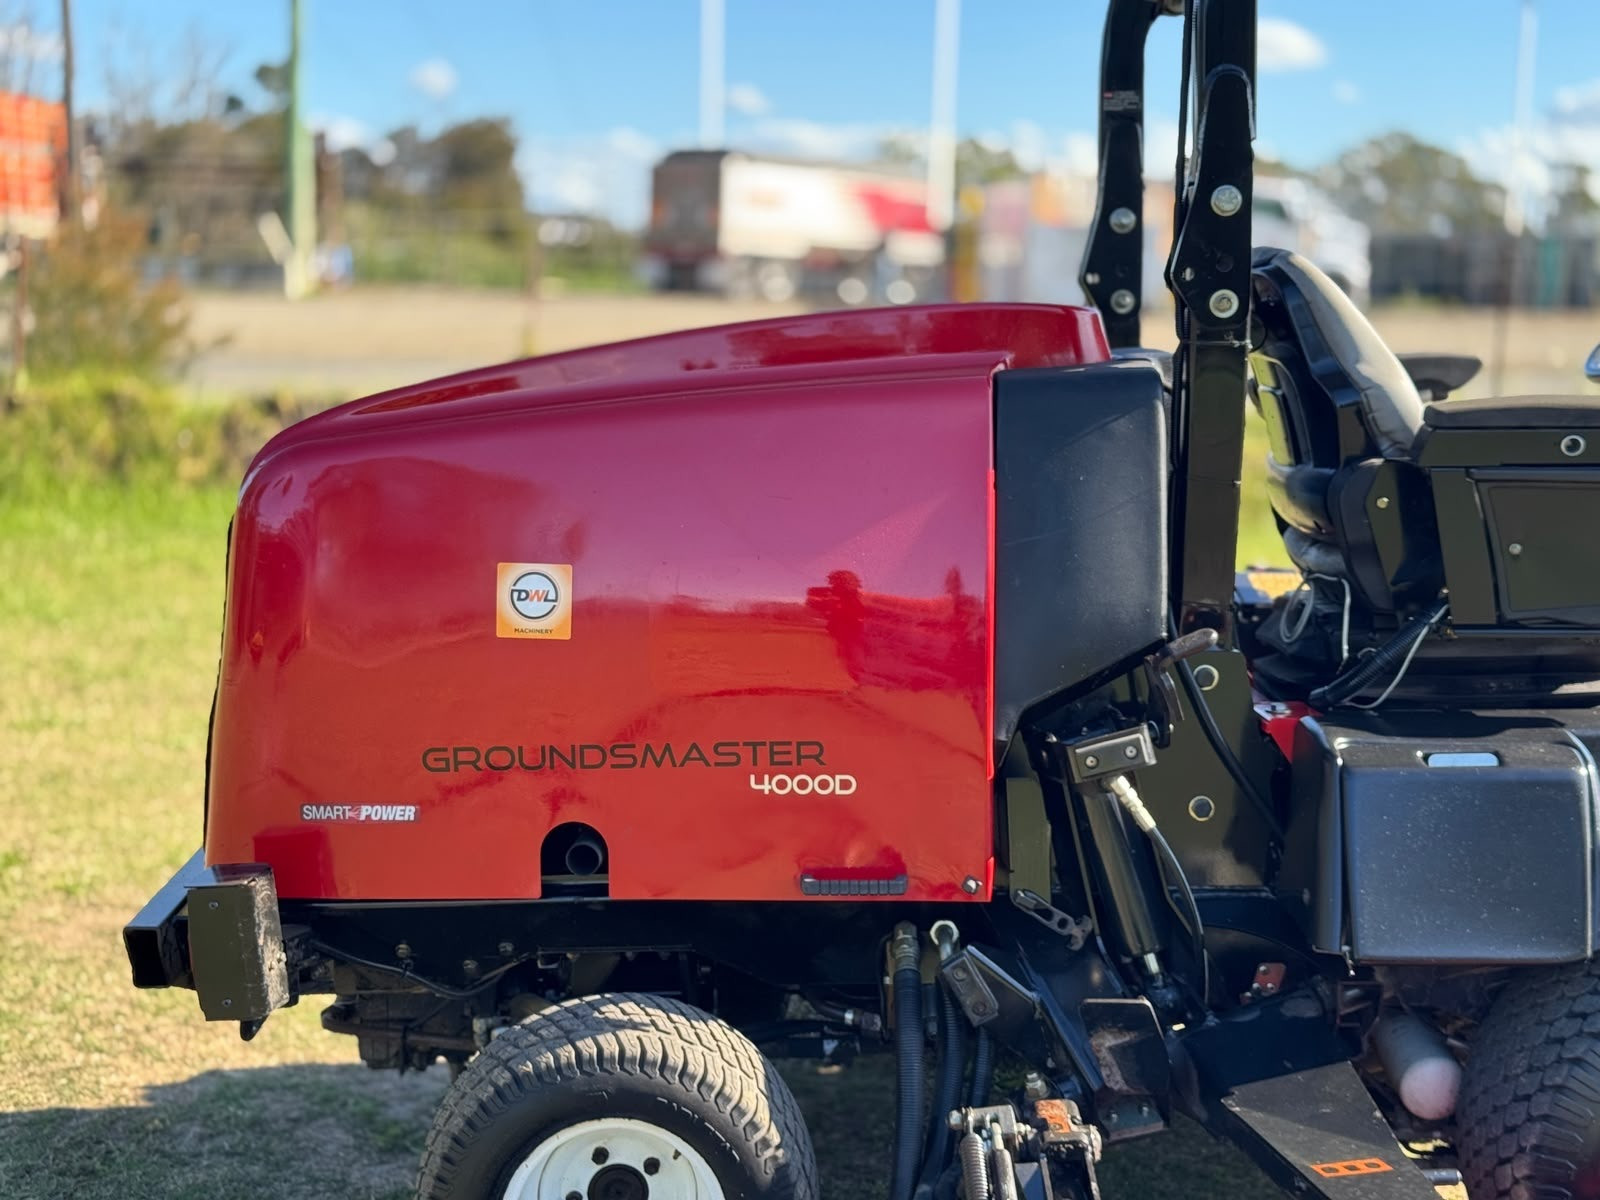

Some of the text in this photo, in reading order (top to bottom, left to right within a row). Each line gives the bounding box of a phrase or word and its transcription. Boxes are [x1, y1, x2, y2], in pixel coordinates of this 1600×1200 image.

[510, 588, 558, 603] DWL
[513, 627, 555, 635] MACHINERY
[421, 740, 827, 773] GROUNDSMASTER
[750, 773, 858, 795] 4000D
[302, 804, 416, 821] SMART POWER
